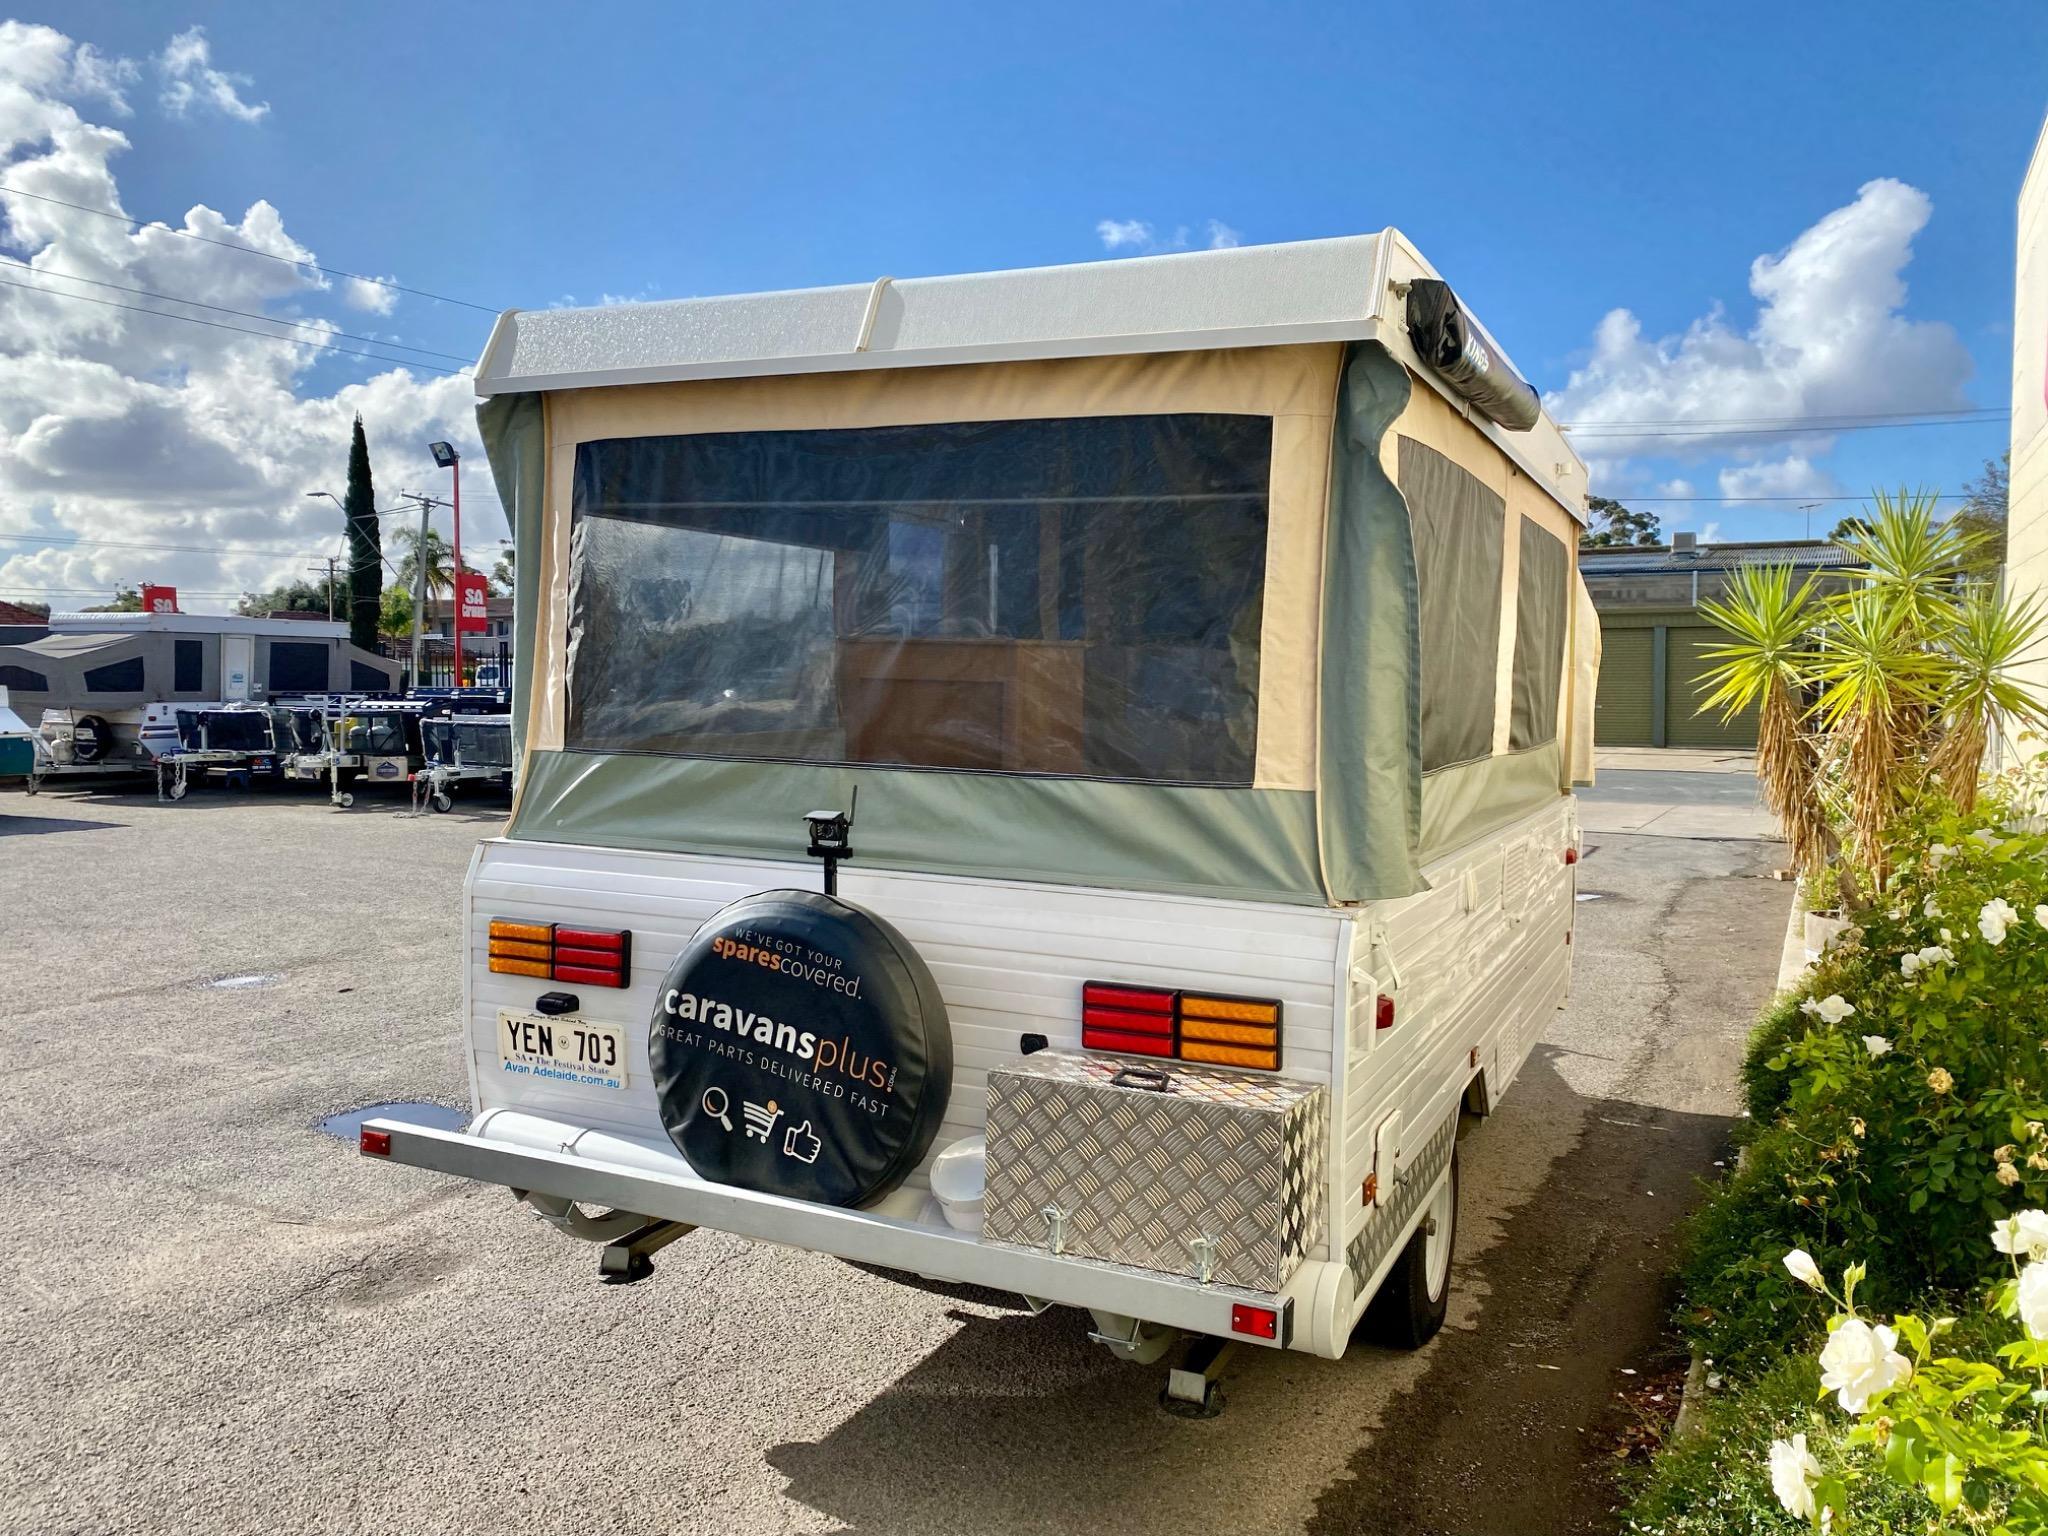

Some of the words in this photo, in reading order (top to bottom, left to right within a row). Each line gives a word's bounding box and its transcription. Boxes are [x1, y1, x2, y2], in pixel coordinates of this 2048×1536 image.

[1464, 332, 1490, 374] KINGS
[153, 598, 174, 612] SA
[465, 587, 484, 604] SA
[735, 926, 773, 948] WE'VE
[775, 940, 802, 956] GOT
[807, 948, 843, 971] YOUR
[506, 1020, 554, 1057] YEN
[574, 1030, 617, 1067] 703
[664, 987, 888, 1089] caravansplus
[504, 1061, 530, 1075] Avan
[532, 1066, 620, 1089] Adelaide.com.au
[515, 1053, 527, 1063] SA
[536, 1056, 551, 1067] The
[553, 1059, 586, 1073] Festival
[588, 1064, 610, 1076] State
[658, 1023, 703, 1048] GREAT
[708, 1039, 754, 1066] PARTS
[760, 1056, 845, 1099] DELIVERED
[850, 1091, 889, 1118] FAST
